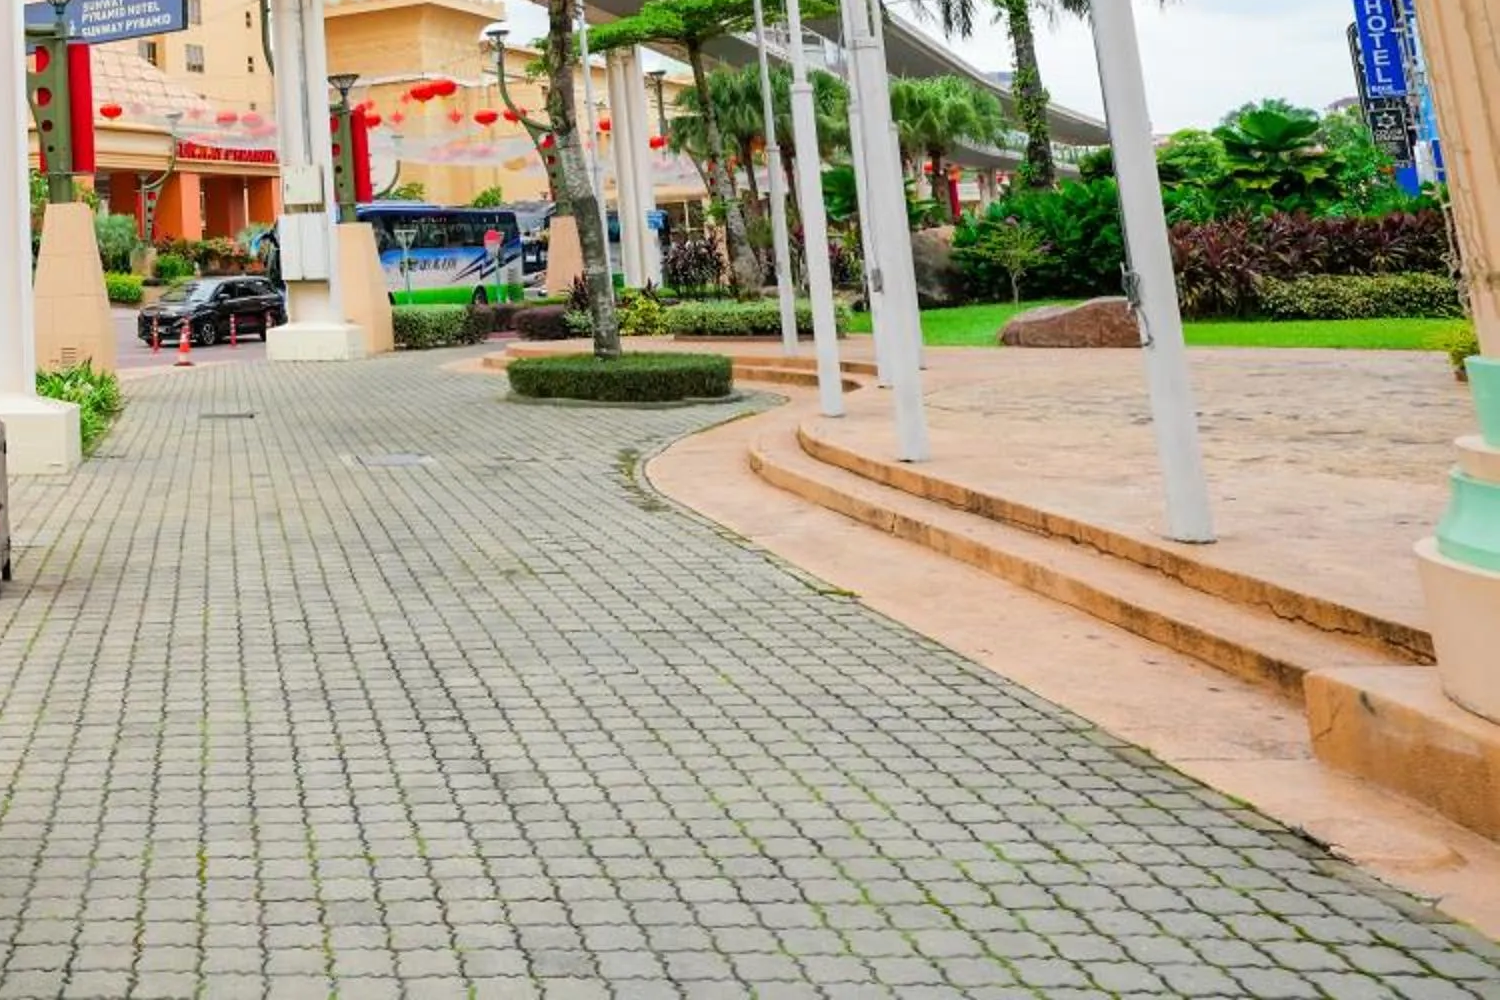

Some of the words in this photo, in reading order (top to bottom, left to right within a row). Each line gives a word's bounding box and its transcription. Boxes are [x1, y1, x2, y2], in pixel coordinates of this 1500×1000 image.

[82, 6, 126, 24] PYRAMID
[127, 1, 161, 16] HOTEL
[82, 21, 124, 37] SUNWAY
[125, 13, 171, 31] PYRAMID
